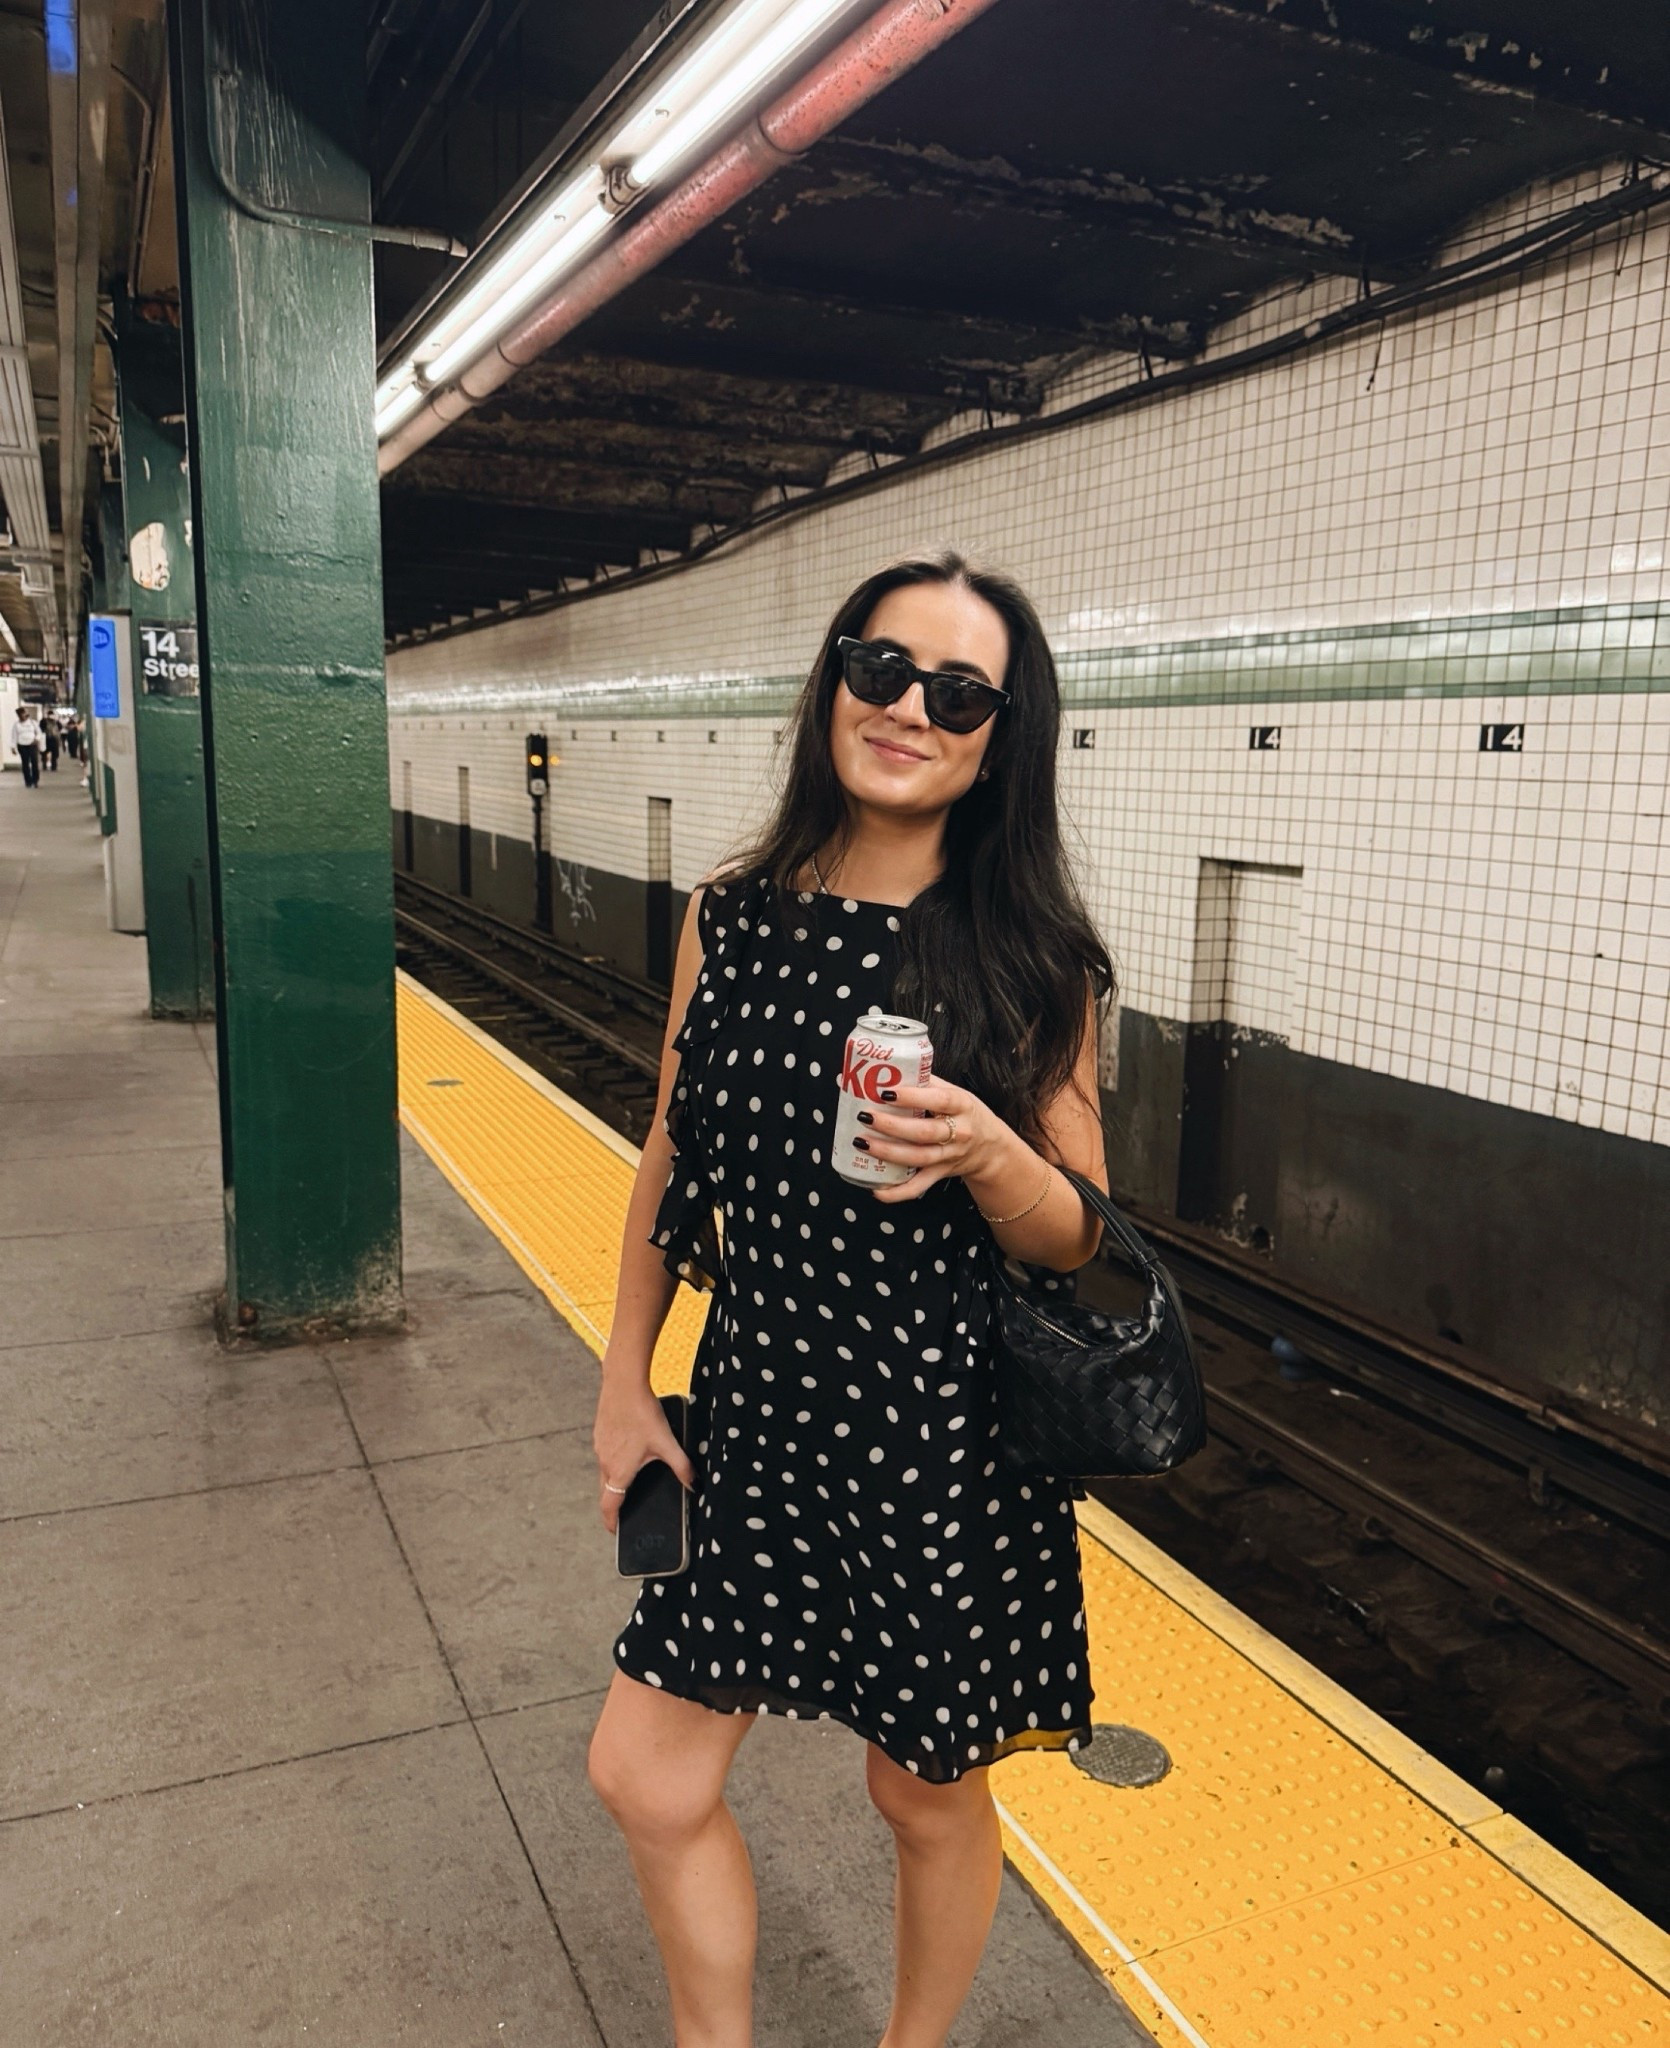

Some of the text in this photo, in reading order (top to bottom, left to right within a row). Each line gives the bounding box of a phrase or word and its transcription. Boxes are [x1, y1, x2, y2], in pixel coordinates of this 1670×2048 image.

[142, 630, 180, 657] 14
[143, 658, 199, 680] Stree
[1075, 730, 1094, 748] 14
[1254, 728, 1280, 749] 14
[1486, 725, 1522, 750] 14
[857, 1038, 894, 1061] Diet
[842, 1039, 902, 1104] ke
